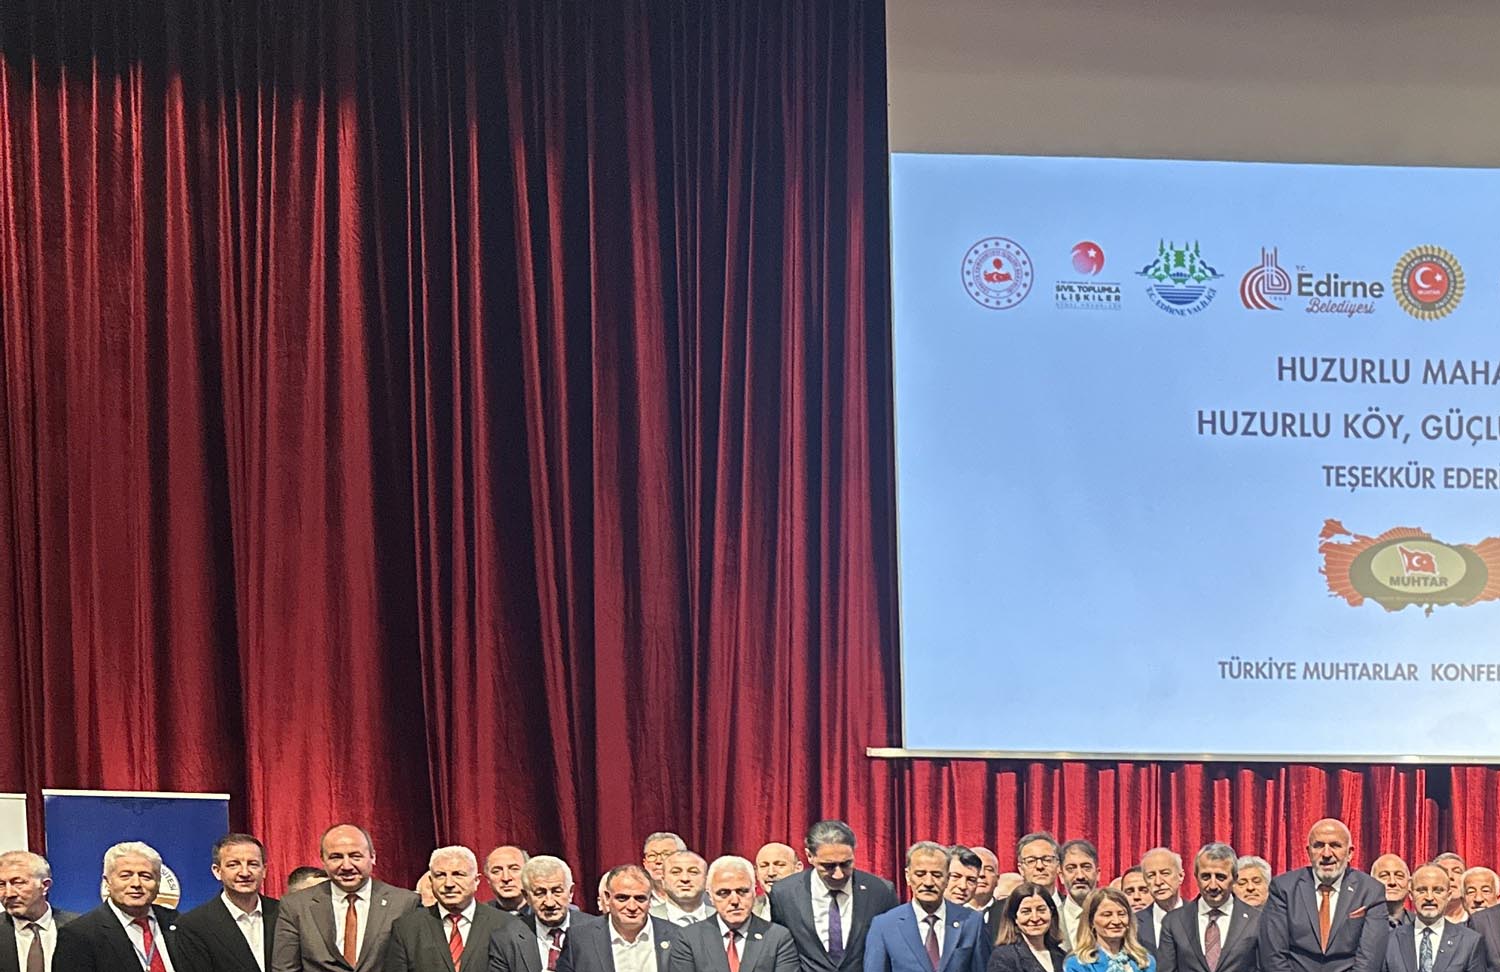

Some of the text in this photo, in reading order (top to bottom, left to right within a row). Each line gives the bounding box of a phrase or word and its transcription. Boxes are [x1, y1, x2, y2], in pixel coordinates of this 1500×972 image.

[1297, 273, 1385, 299] Edirne
[1305, 297, 1376, 318] Belediyesi
[1277, 357, 1410, 384] HUZURLU
[1198, 410, 1331, 438] HUZURLU
[1343, 406, 1411, 445] KÖY,
[1322, 461, 1436, 492] TEŞEKKÜR
[1389, 575, 1449, 588] MUHTAR
[1218, 656, 1297, 680] TÜRKİYE
[1302, 662, 1419, 681] MUHTARLAR
